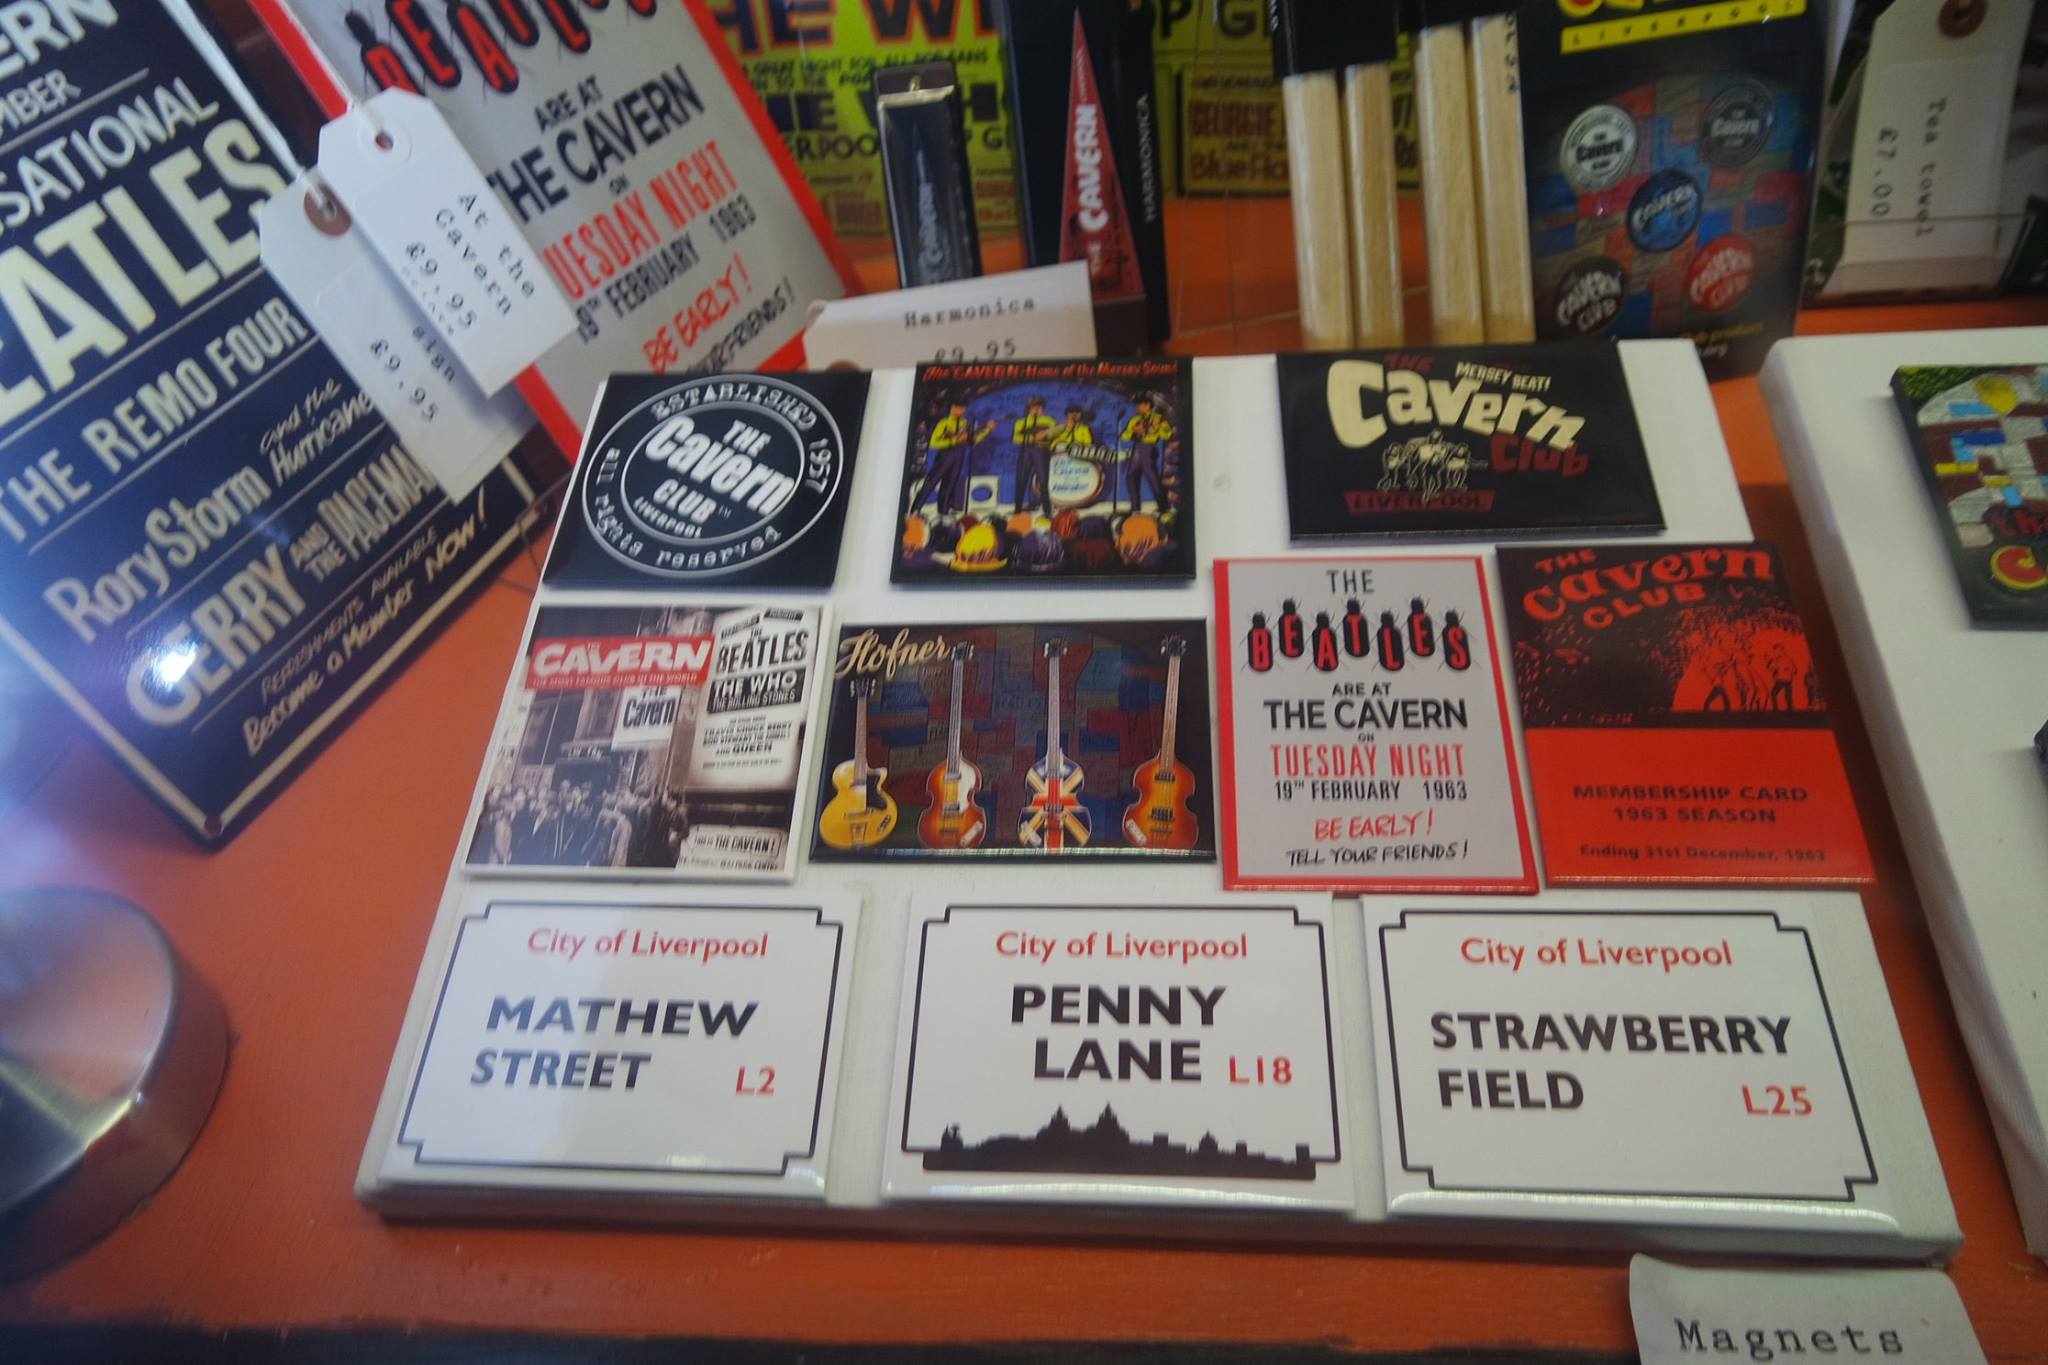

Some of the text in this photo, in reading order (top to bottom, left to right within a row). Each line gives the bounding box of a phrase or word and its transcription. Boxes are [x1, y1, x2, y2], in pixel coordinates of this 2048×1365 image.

[534, 74, 603, 134] ARE AT
[1924, 97, 1948, 144] Tea
[485, 145, 570, 225] HE
[556, 63, 705, 184] CAVERN
[1136, 94, 1157, 223] HARMONICA
[1075, 104, 1109, 231] CAVERN
[543, 190, 661, 300] UESDAY
[649, 139, 738, 231] NIGHT
[435, 208, 512, 317] Cavern
[458, 192, 536, 298] At the
[604, 232, 701, 319] FEBRUARY
[708, 193, 757, 244] 1963
[405, 241, 477, 330] £9.95
[641, 324, 680, 375] BE
[672, 251, 752, 349] EARLY!
[904, 298, 1036, 330] Harmonica
[412, 325, 457, 383] sign
[1455, 361, 1513, 387] MERSEY
[81, 358, 219, 475] REMO
[204, 297, 309, 390] FOUR
[370, 338, 438, 423] £9.95
[1327, 358, 1586, 452] Cavern
[652, 382, 832, 495] ESTABLISHED 1957
[722, 419, 772, 458] THE
[1490, 431, 1590, 479] Club
[645, 414, 796, 517] Cavern
[317, 443, 438, 561] PACEMA
[633, 496, 703, 539] LIVERPOOL
[652, 478, 718, 524] CLUB
[43, 465, 273, 645] Rory Storm
[305, 539, 347, 582] THE
[655, 525, 783, 570] reserved
[1535, 547, 1597, 575] THE
[1326, 569, 1376, 595] THE
[1523, 547, 1775, 622] Cavern
[1583, 582, 1707, 630] CLUB
[126, 543, 307, 728] GERRY
[715, 629, 809, 674] BEATLES
[1248, 606, 1472, 672] BEATLES
[242, 665, 326, 756] Become
[341, 579, 415, 661] Member
[534, 640, 713, 678] CAVERN
[713, 669, 798, 699] THE WHO
[1331, 682, 1393, 697] ARE AT
[623, 697, 677, 729] Cavern
[1263, 698, 1469, 730] THE CAVERN
[1269, 743, 1466, 778] TUESDAY NIGHT
[1357, 732, 1376, 744] ON
[1311, 778, 1401, 801] FEBRUARY
[1422, 780, 1468, 801] 1963
[1572, 784, 1809, 802] MEMBERSHIP CARD
[1314, 808, 1434, 842] BE EARLY!
[1614, 806, 1778, 823] 1963 SEASON
[1285, 839, 1469, 868] TELL YOUR FRIENDS!
[1579, 844, 1641, 861] Ending
[1645, 845, 1681, 860] 31st
[527, 928, 769, 965] City of Liverpool
[995, 931, 1248, 965] City of Liverpool
[1459, 937, 1733, 973] City of Liverpool
[485, 994, 760, 1038] MATHEW
[1011, 984, 1228, 1026] PENNY
[1430, 1012, 1792, 1055] STRAWBERRY
[469, 1048, 777, 1096] STREET L2
[1033, 1038, 1293, 1085] LANE L18
[1437, 1068, 1814, 1117] FIELD L25
[1674, 1316, 1905, 1359] Magnets
